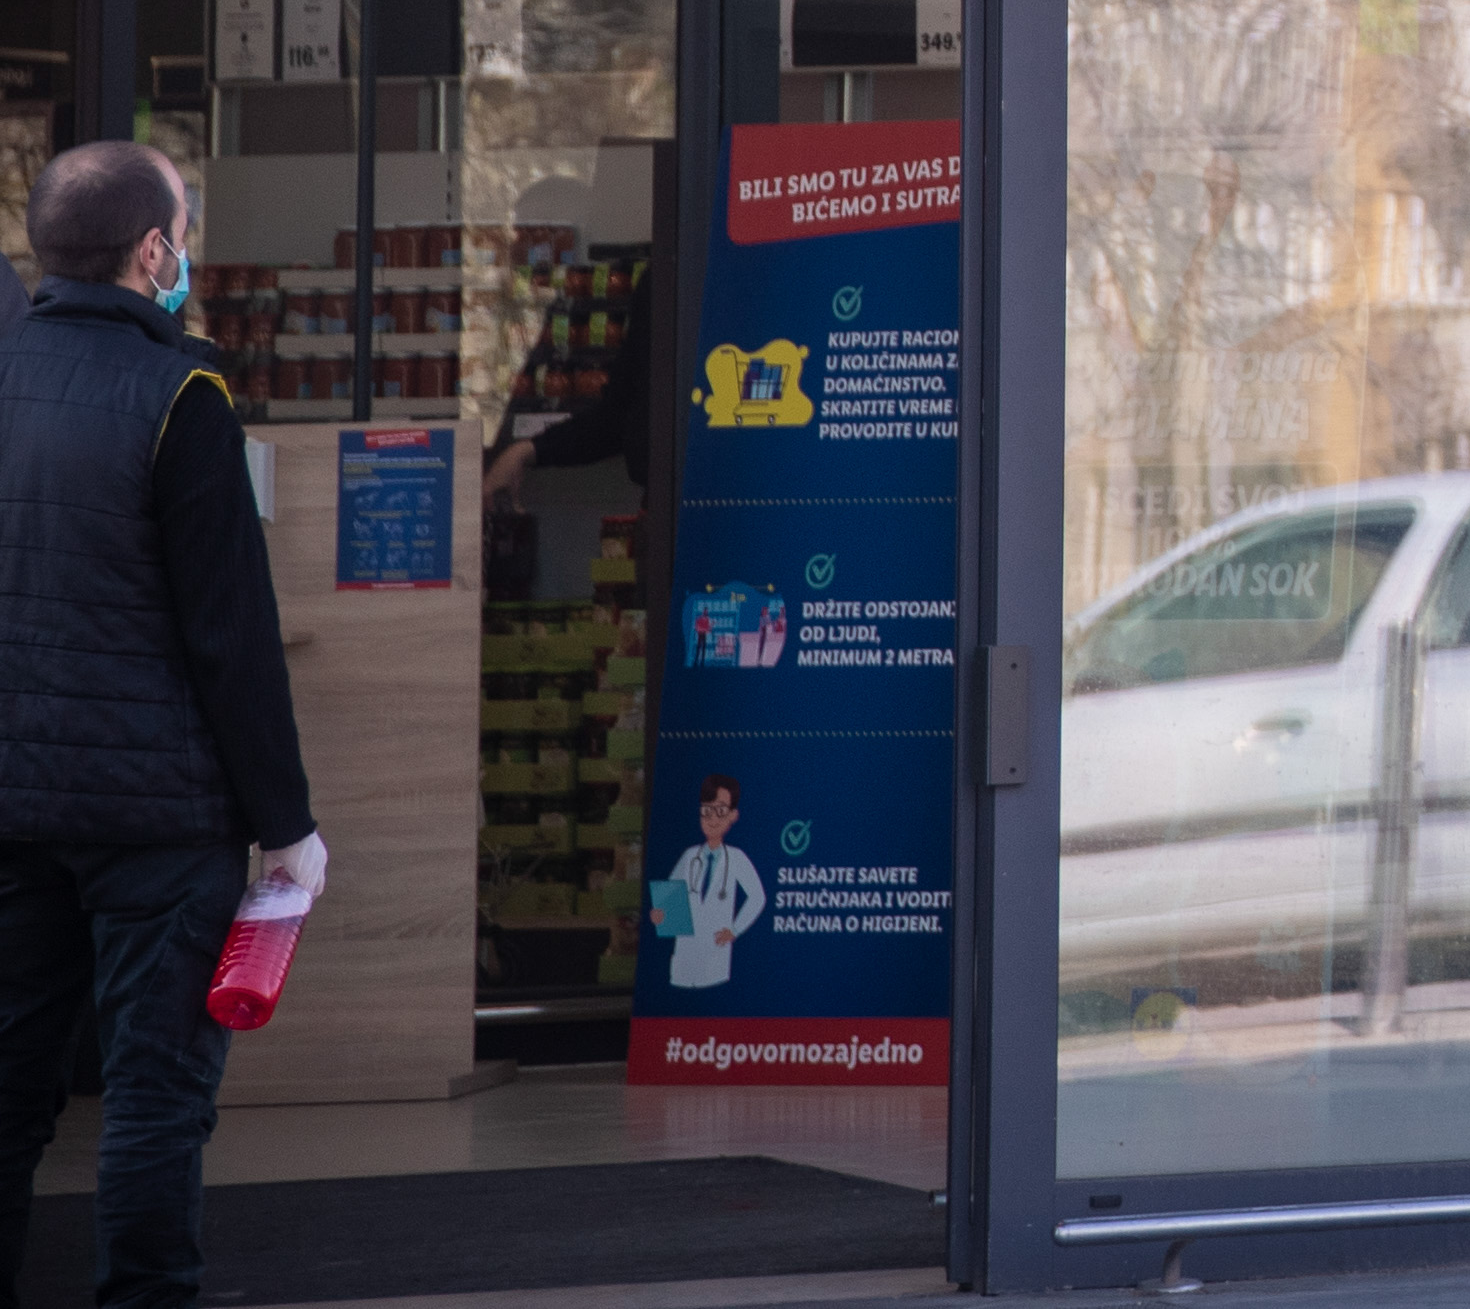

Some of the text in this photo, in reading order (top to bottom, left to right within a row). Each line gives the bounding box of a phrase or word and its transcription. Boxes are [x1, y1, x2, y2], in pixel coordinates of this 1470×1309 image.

[739, 178, 783, 201] BILI
[787, 171, 835, 195] SMO
[840, 167, 868, 188] TU
[872, 164, 899, 186] ZA
[902, 157, 944, 182] VAS
[792, 186, 961, 223] BIĆEMO I SUTRA
[828, 331, 899, 348] KUPUJTE
[826, 351, 960, 371] U KOLIČINAMA Z
[823, 374, 946, 394] DOMAĆINSTVO.
[821, 399, 896, 416] SKRATITE
[899, 398, 952, 415] VREME
[819, 422, 913, 440] PROVODITE
[915, 422, 927, 439] U
[1249, 561, 1320, 598] SOK
[802, 598, 862, 619] DRŽITE
[800, 624, 881, 645] OD LJUDI,
[798, 648, 954, 666] MINIMUM 2 METRA
[777, 864, 918, 884] SLUŠAJTE SAVETE
[775, 887, 953, 908] STRUČNJAKA I VODIT
[773, 913, 943, 933] RAČUNA O HIGIJENI.
[665, 1035, 924, 1071] #odgovornozajedno
